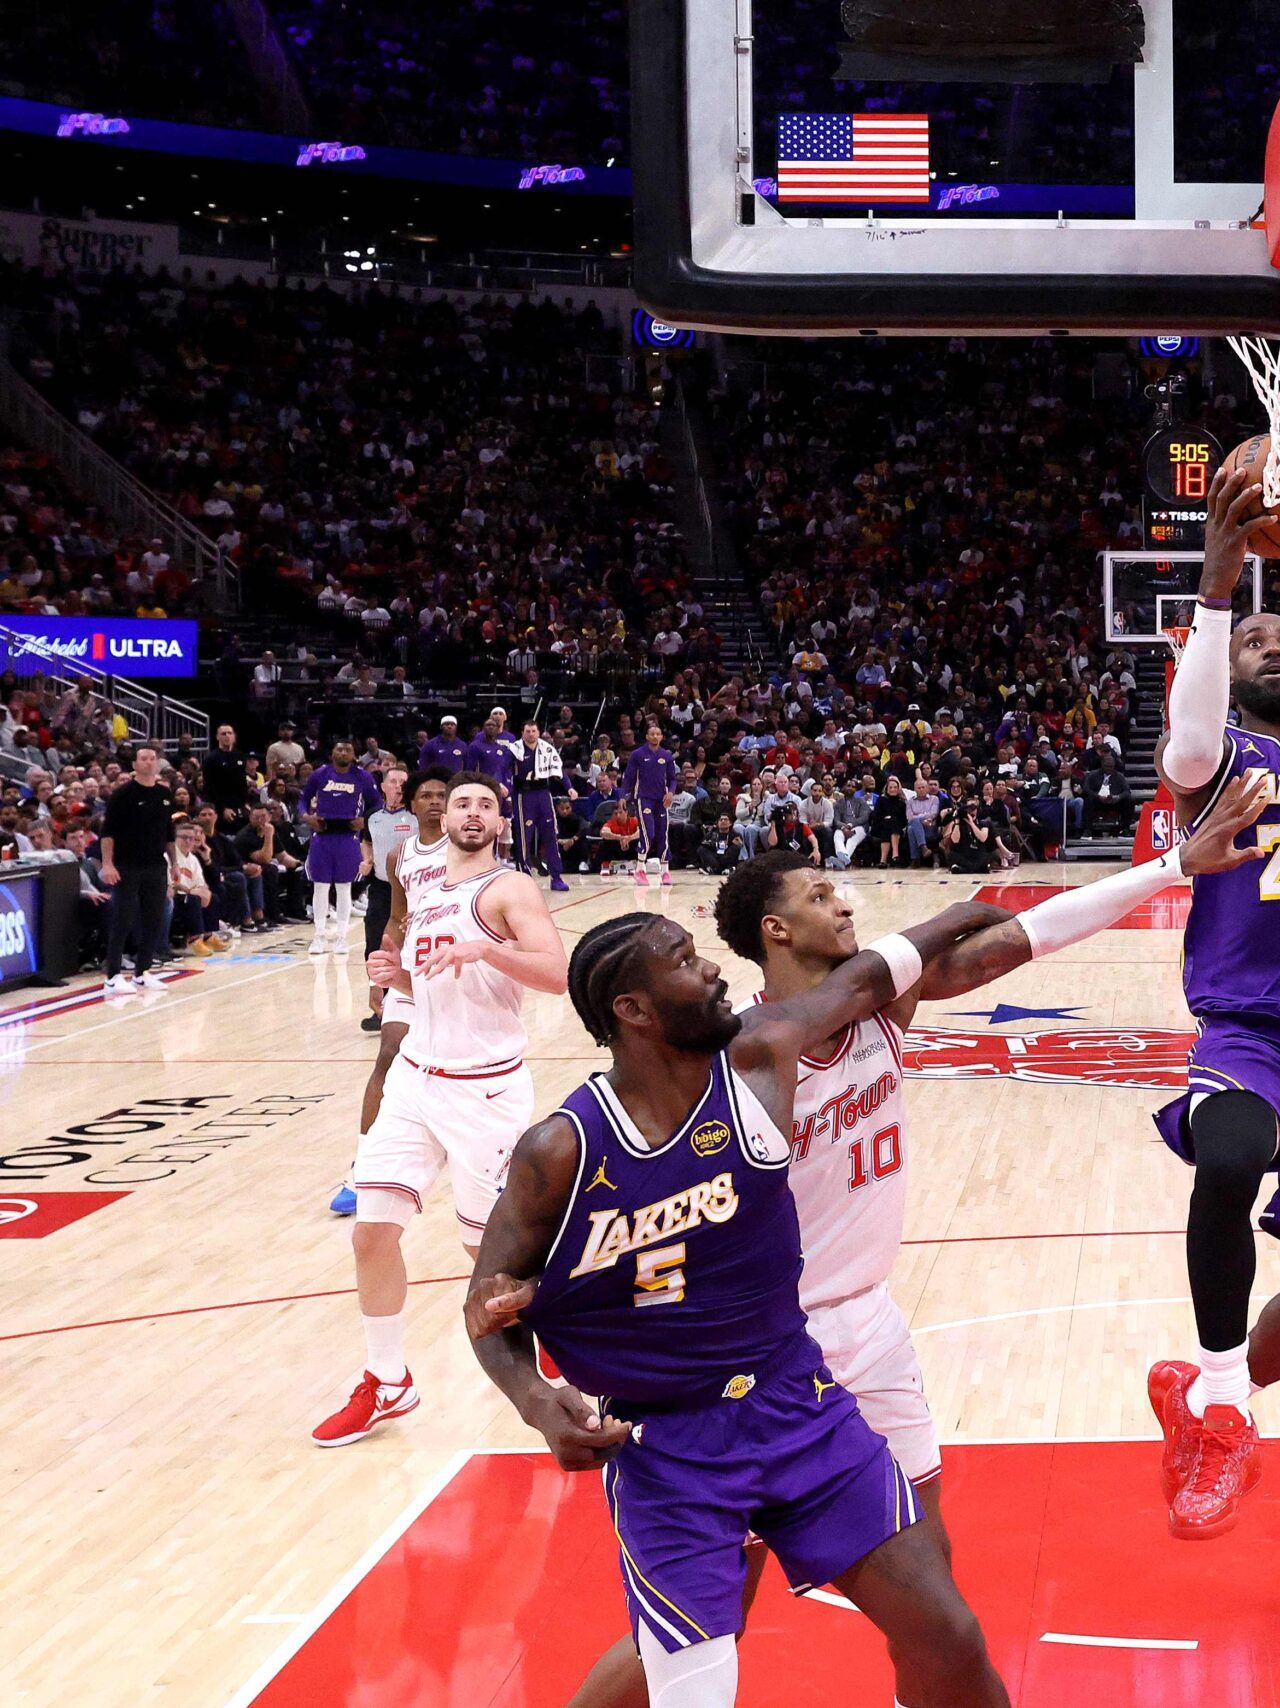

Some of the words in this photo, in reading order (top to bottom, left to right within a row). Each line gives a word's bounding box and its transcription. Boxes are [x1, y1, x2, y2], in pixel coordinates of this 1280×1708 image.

[518, 164, 585, 189] H-Town
[937, 184, 1000, 210] H-Town
[1169, 443, 1209, 462] 9:05
[1175, 463, 1205, 496] 18
[1168, 511, 1208, 521] TISSO
[110, 638, 183, 657] ULTRA
[790, 1071, 897, 1164] H-Town
[84, 1093, 336, 1185] CENTER
[849, 1122, 904, 1193] 10
[570, 1173, 739, 1279] LAKERS
[633, 1242, 686, 1308] 5
[721, 1374, 756, 1398] LAKERS
